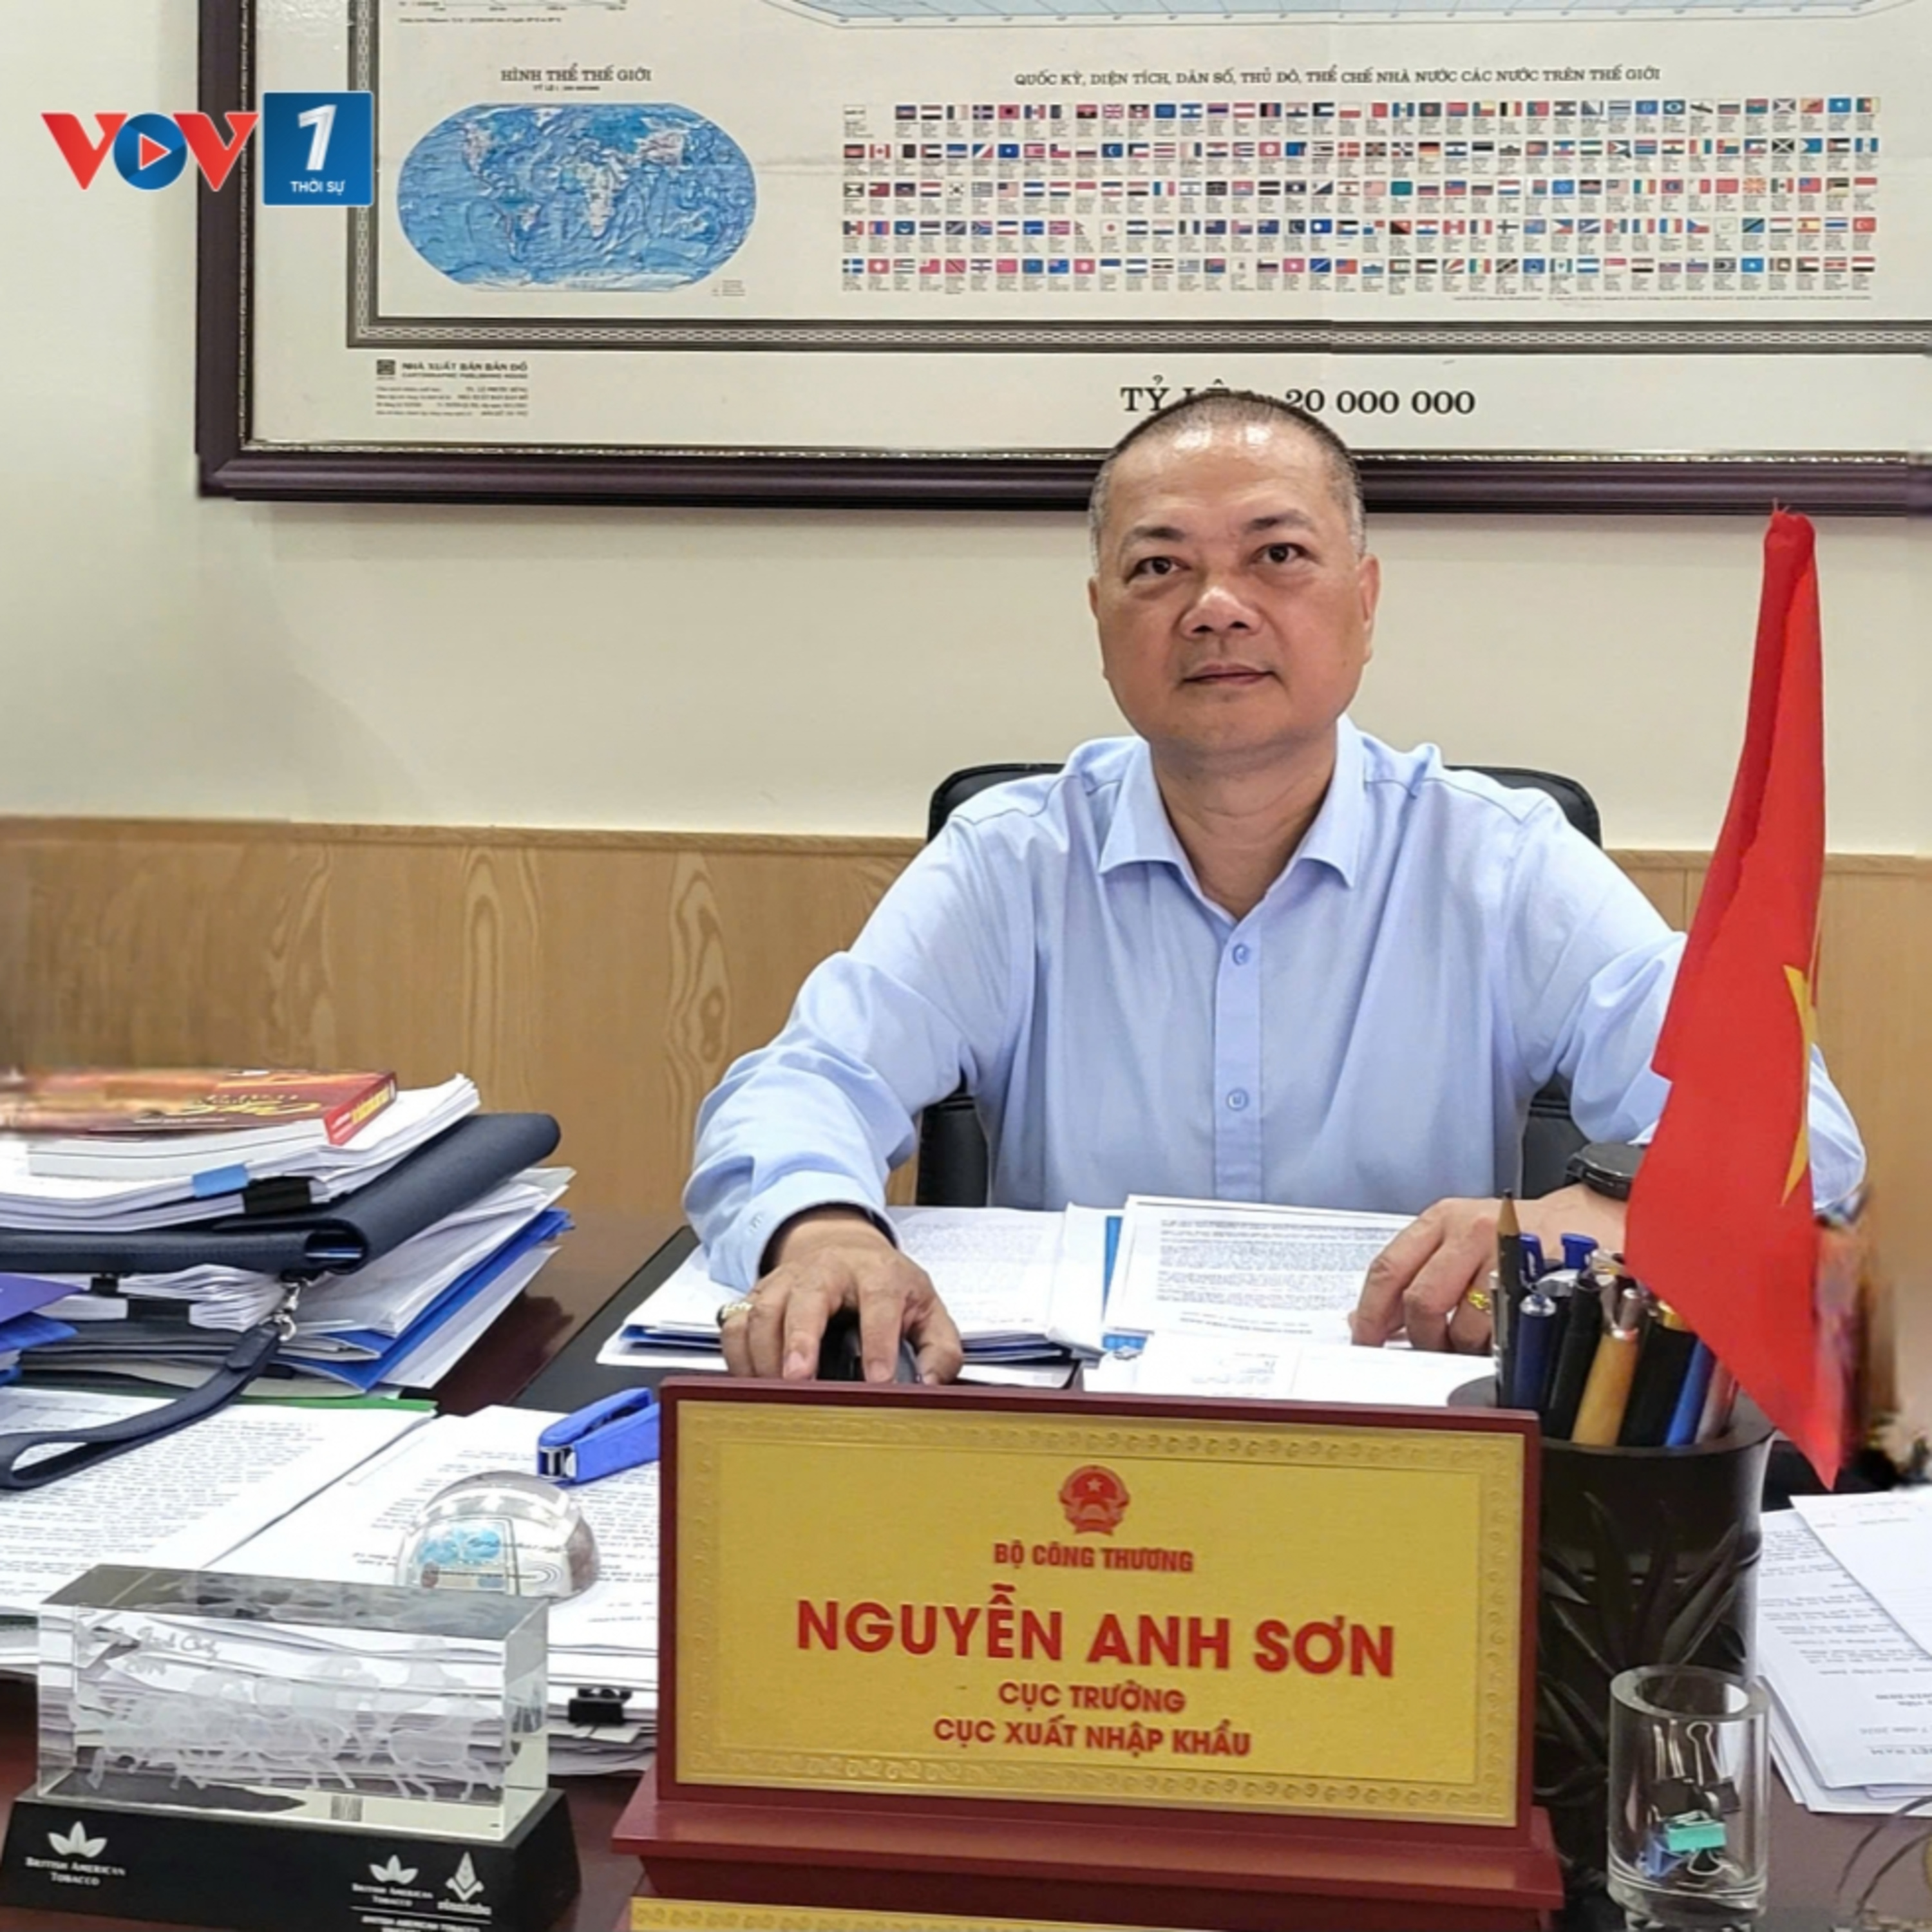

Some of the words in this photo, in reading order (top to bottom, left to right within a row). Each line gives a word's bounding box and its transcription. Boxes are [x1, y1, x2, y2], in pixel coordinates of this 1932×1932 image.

[501, 66, 542, 81] HÌNH
[582, 64, 614, 81] THẾ
[617, 66, 652, 81] GIỚI
[1014, 68, 1057, 85] QUỐC
[1090, 70, 1128, 86] DIỆN
[1176, 70, 1209, 84] DÂN
[1241, 67, 1271, 83] THỦ
[1341, 66, 1374, 83] CHẾ
[1376, 68, 1410, 83] NHÀ
[1415, 67, 1457, 83] NƯỚC
[1461, 67, 1492, 82] CÁC
[1496, 66, 1539, 82] NƯỚC
[1543, 66, 1584, 82] TRÊN
[1589, 64, 1622, 81] THẾ
[1625, 66, 1660, 80] GIỚI
[1120, 374, 1170, 412] TỶ
[1336, 390, 1399, 415] 000
[1411, 390, 1475, 415] 000
[993, 1539, 1025, 1569] BỘ
[1032, 1540, 1095, 1568] CÔNG
[1100, 1546, 1194, 1572] THƯƠNG
[797, 1582, 1063, 1662] NGUYỄN
[1086, 1613, 1231, 1671] ANH
[1253, 1615, 1394, 1678] SƠN
[998, 1681, 1061, 1712] CỤC
[1069, 1679, 1186, 1714] TRƯỞNG
[933, 1718, 996, 1748] CỤC
[1004, 1714, 1077, 1748] XUẤT
[1085, 1721, 1164, 1758] NHẬP
[1172, 1718, 1252, 1757] KHẨU
